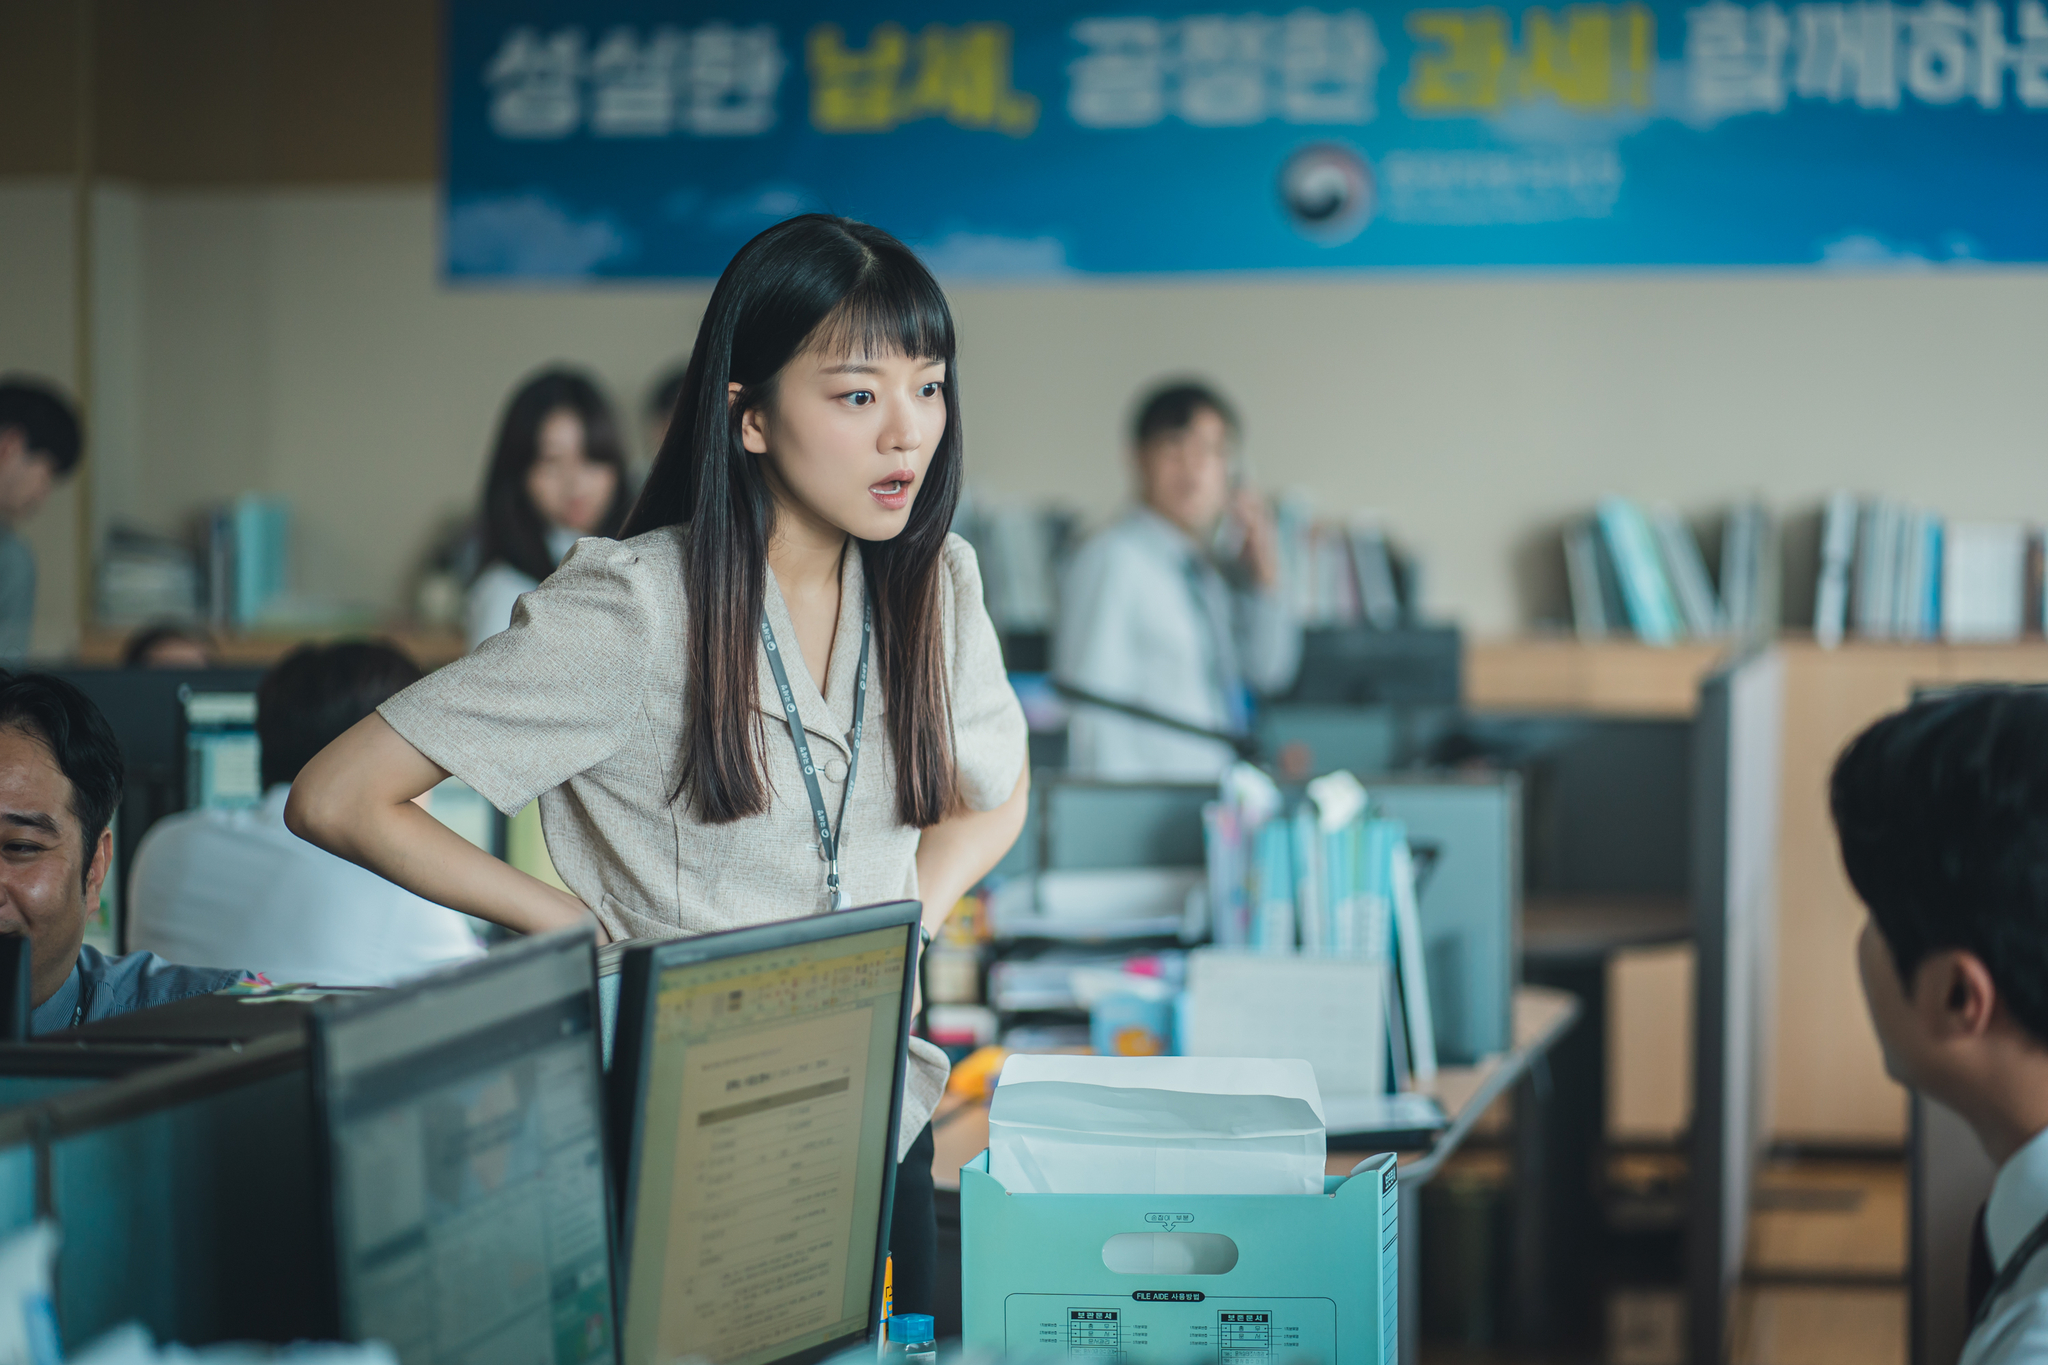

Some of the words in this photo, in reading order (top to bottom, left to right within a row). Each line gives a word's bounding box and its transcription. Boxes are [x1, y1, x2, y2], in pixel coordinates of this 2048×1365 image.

[486, 24, 785, 137] 성실한
[808, 22, 1038, 136] 납세,
[1067, 12, 1379, 127] 공정한
[1409, 6, 1652, 115] 과세!
[781, 684, 791, 703] 국세청
[799, 746, 810, 766] 국세청
[816, 809, 827, 829] 국세청
[1136, 1292, 1151, 1300] FILE
[1152, 1292, 1169, 1301] AIDE
[1171, 1292, 1200, 1301] 사용방법
